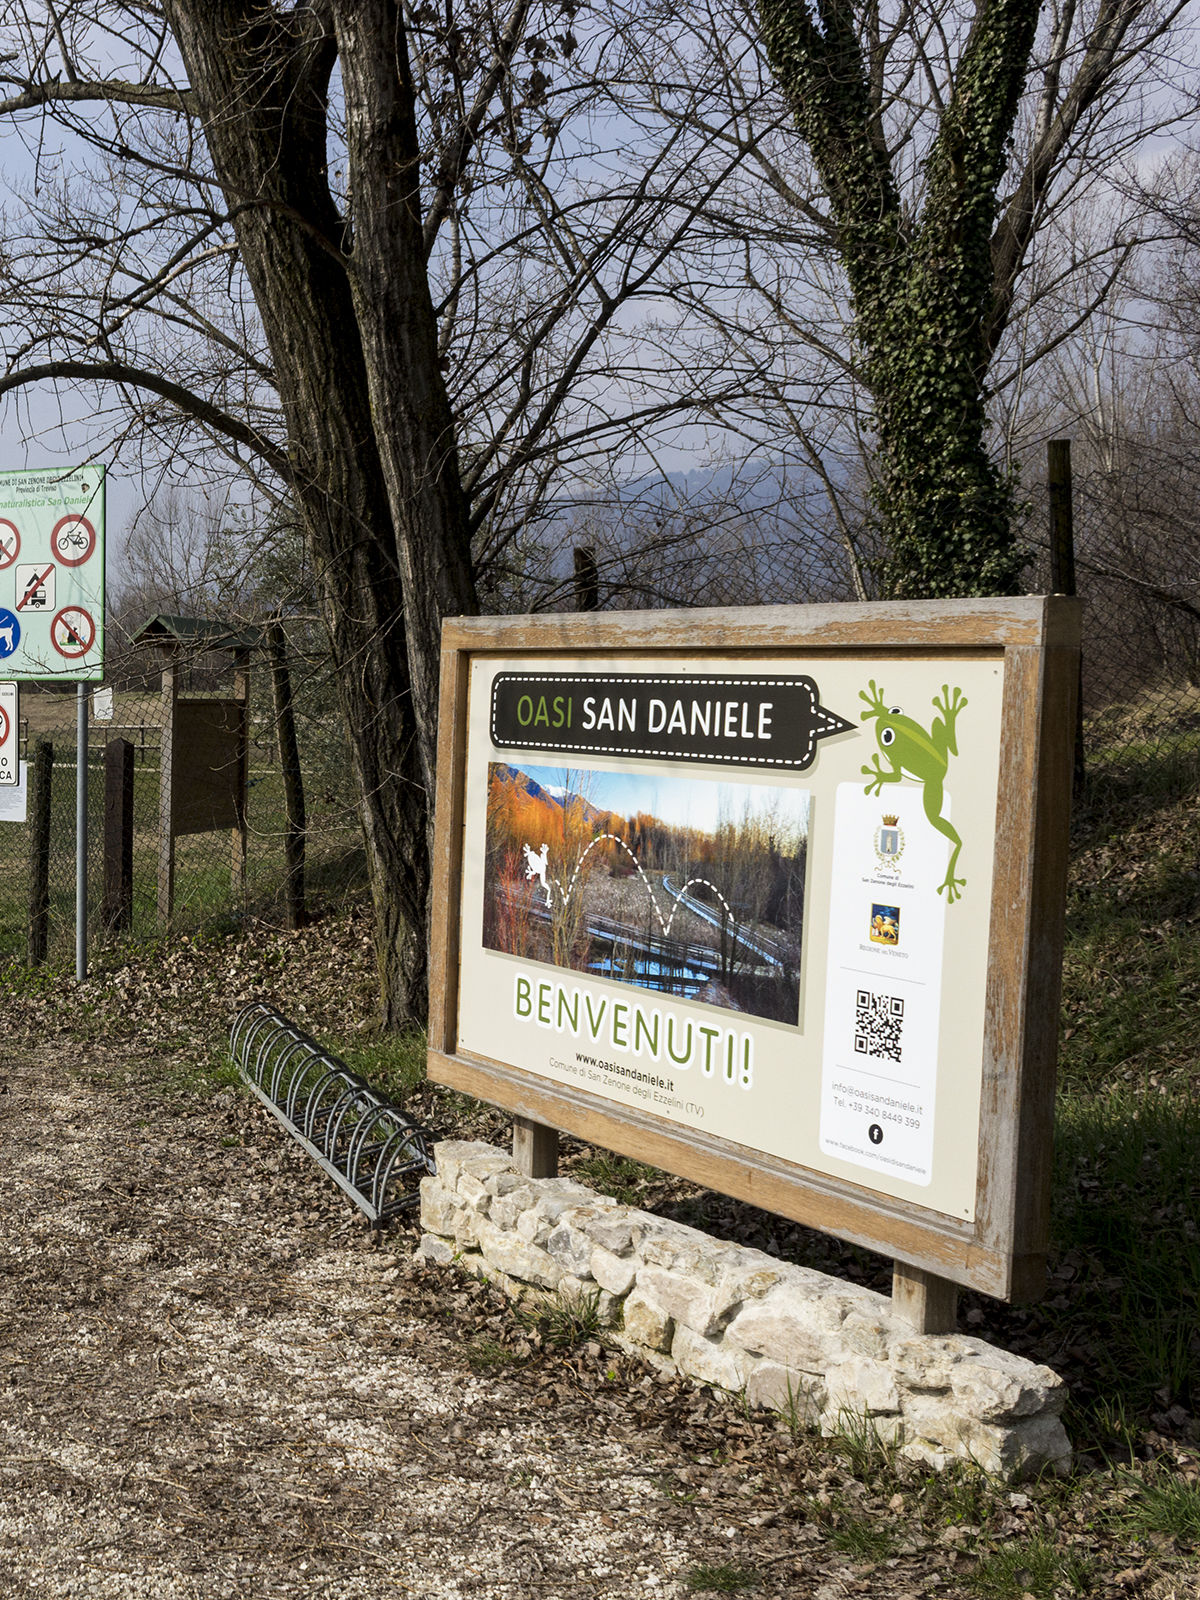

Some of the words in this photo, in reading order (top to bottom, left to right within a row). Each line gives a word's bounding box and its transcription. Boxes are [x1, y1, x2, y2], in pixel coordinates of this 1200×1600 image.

[18, 478, 27, 486] SAN
[28, 477, 46, 485] ZENONE
[0, 499, 45, 508] naturalistica
[48, 498, 61, 506] San
[517, 695, 573, 729] OASI
[582, 696, 637, 732] SAN
[648, 699, 774, 739] DANIELE
[516, 977, 751, 1085] BENVENUTI!
[549, 1057, 577, 1075] Comune
[579, 1067, 586, 1078] di
[587, 1070, 601, 1082] San
[603, 1074, 631, 1093] Zenone
[632, 1084, 651, 1100] degli
[653, 1091, 684, 1110] Ezzelini
[686, 1102, 705, 1118] (TV)
[575, 1052, 674, 1092] www.oasisandaniele.it
[831, 1081, 923, 1115] info@oasisandaniele.it
[833, 1096, 846, 1107] Tel.
[849, 1101, 863, 1113] +39
[864, 1105, 880, 1118] 340
[882, 1110, 903, 1125] 8449
[904, 1116, 921, 1130] 399
